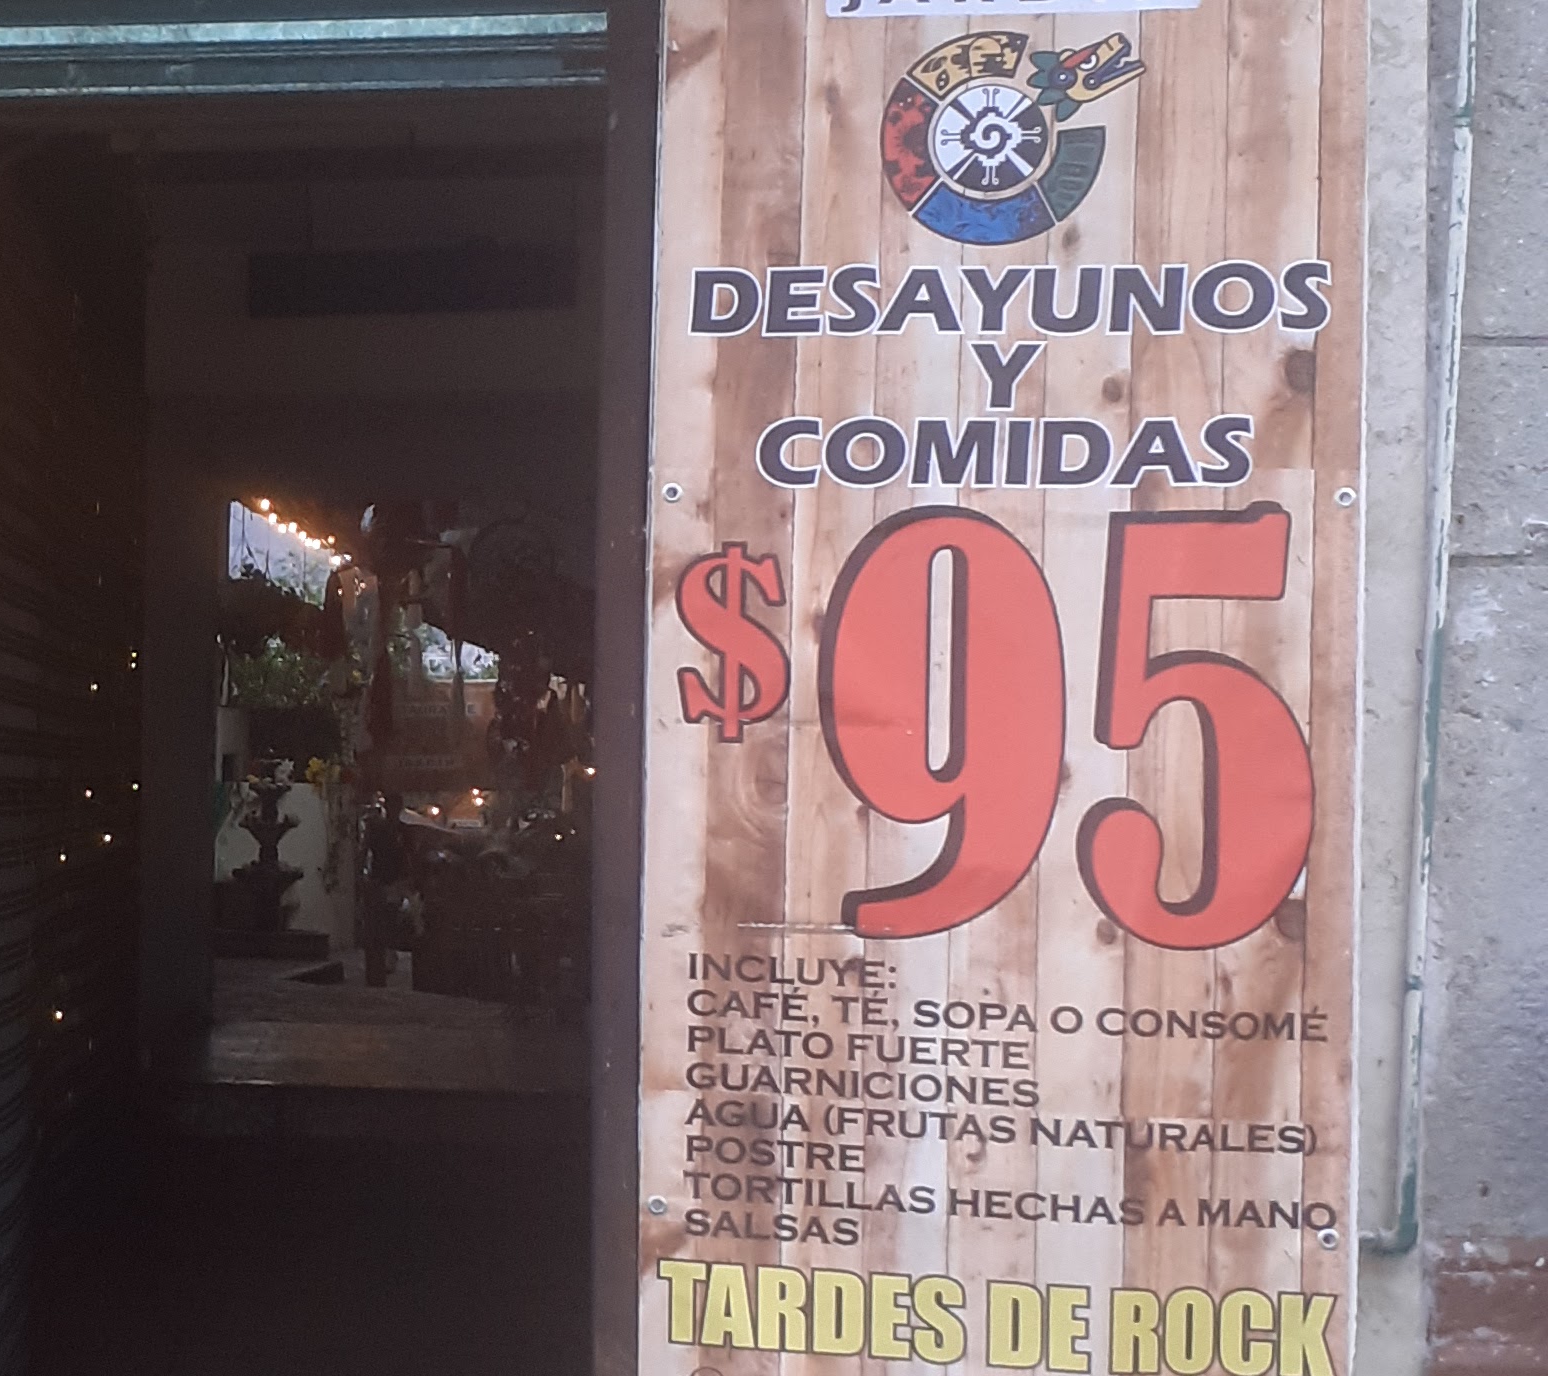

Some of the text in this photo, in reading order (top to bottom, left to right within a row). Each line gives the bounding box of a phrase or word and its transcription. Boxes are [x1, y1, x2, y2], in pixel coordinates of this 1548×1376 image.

[689, 259, 1331, 336] DESAYUNOS
[968, 341, 1046, 411] Y
[756, 414, 1254, 489] COMIDAS
[688, 953, 897, 990] INCLUYE:
[686, 989, 1328, 1042] CAFÉ, TÉ, SOPA O CONSOMÉ
[688, 1026, 1031, 1070] PLATO FUERTE
[685, 1062, 1040, 1108] GUARNICIONES
[684, 1099, 1318, 1156] AGUA (FRUTAS NATURALES)
[686, 1136, 865, 1173] POSTRE
[683, 1171, 1338, 1231] TORTILLAS HECHAS A MANO
[684, 1208, 860, 1248] SALSAS
[659, 1258, 966, 1365] TARDES
[987, 1281, 1092, 1374] DE
